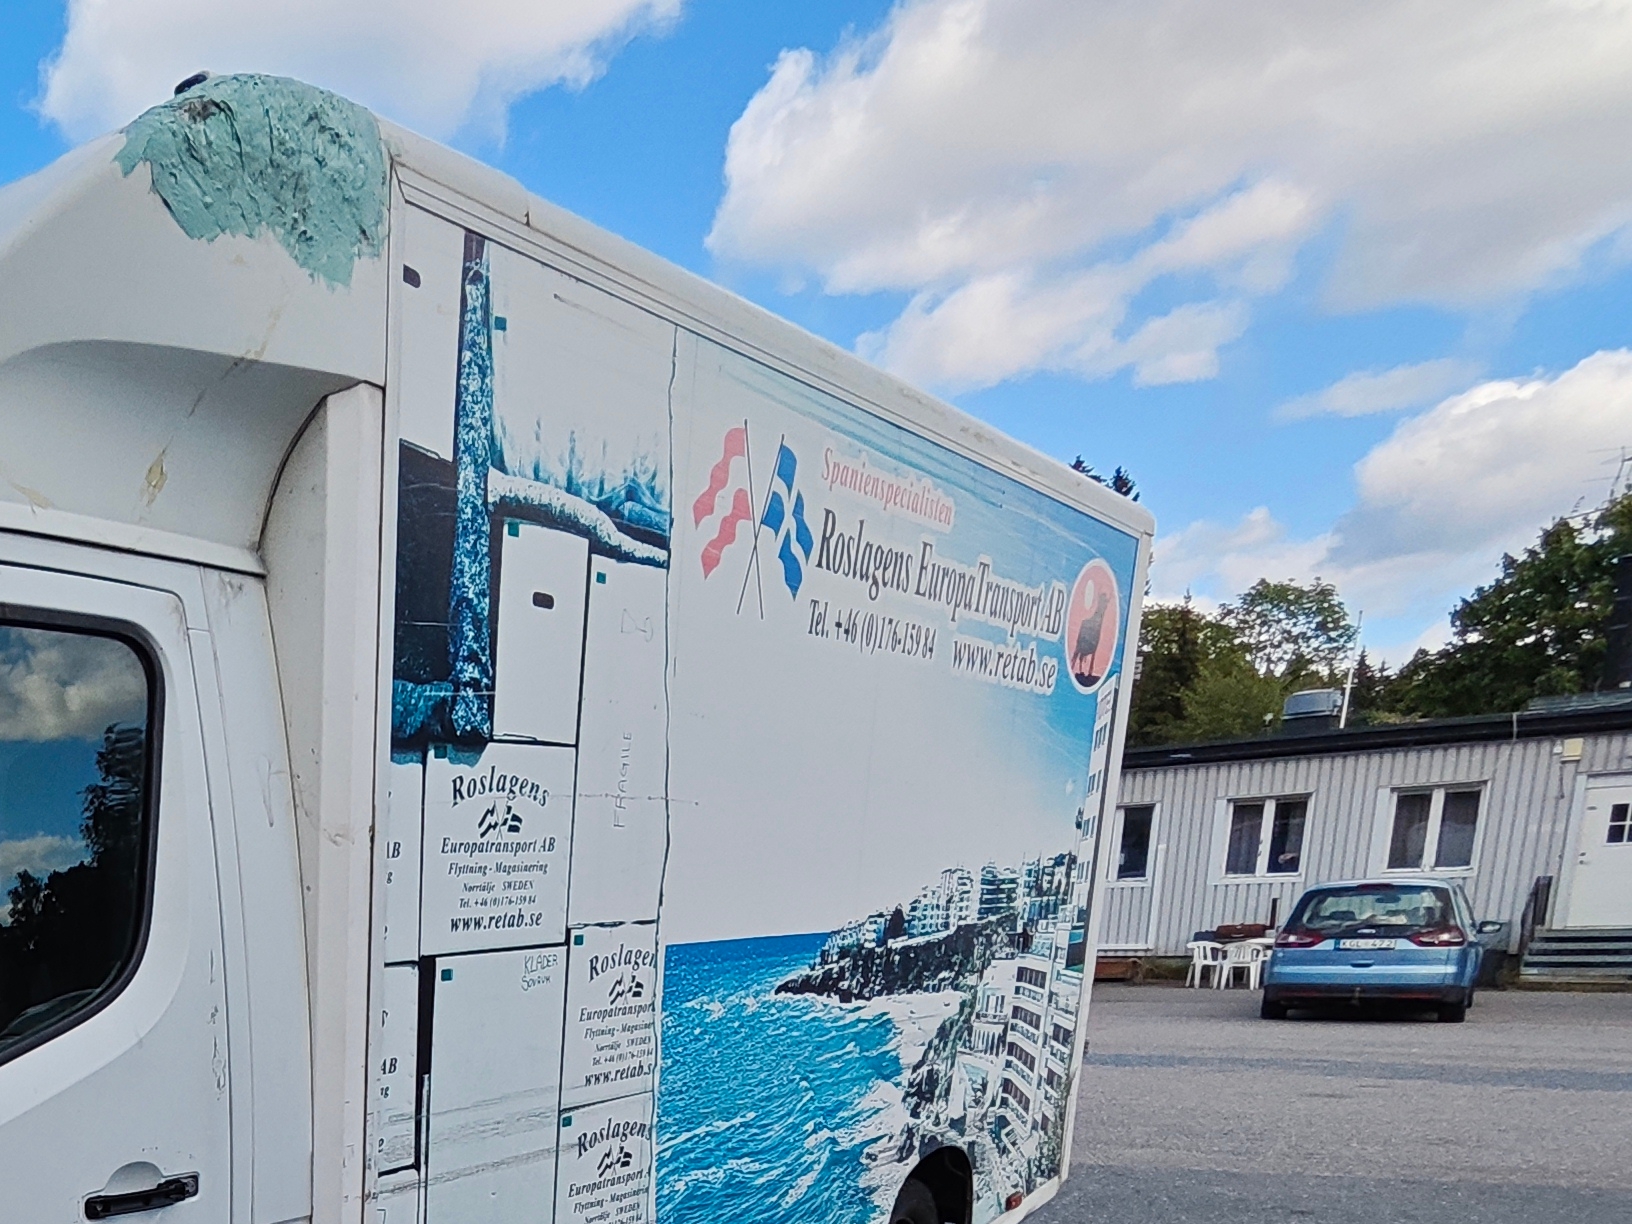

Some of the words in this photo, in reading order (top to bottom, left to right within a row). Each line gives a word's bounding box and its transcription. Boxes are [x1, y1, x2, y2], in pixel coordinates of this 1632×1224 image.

[822, 447, 953, 526] Spanienspecialisten
[815, 507, 914, 601] Roslagens
[914, 541, 1044, 638] EuropaTransport
[1042, 585, 1065, 636] AB
[807, 599, 829, 639] Tel.
[834, 608, 859, 644] +46
[952, 640, 1056, 690] www.retab.se
[451, 765, 550, 808] Roslagens
[613, 731, 632, 828] FRAGILE
[441, 837, 538, 858] Europatransport
[538, 837, 556, 853] AB
[448, 862, 488, 878] Flyttning
[494, 861, 548, 875] Magasinering
[502, 880, 534, 891] SWEDEN
[450, 908, 543, 933] www.retab.se
[459, 898, 472, 909] Tel.
[588, 943, 656, 983] Roslagen
[584, 1060, 653, 1087] www.retab.s
[568, 1169, 644, 1198] Europatransport
